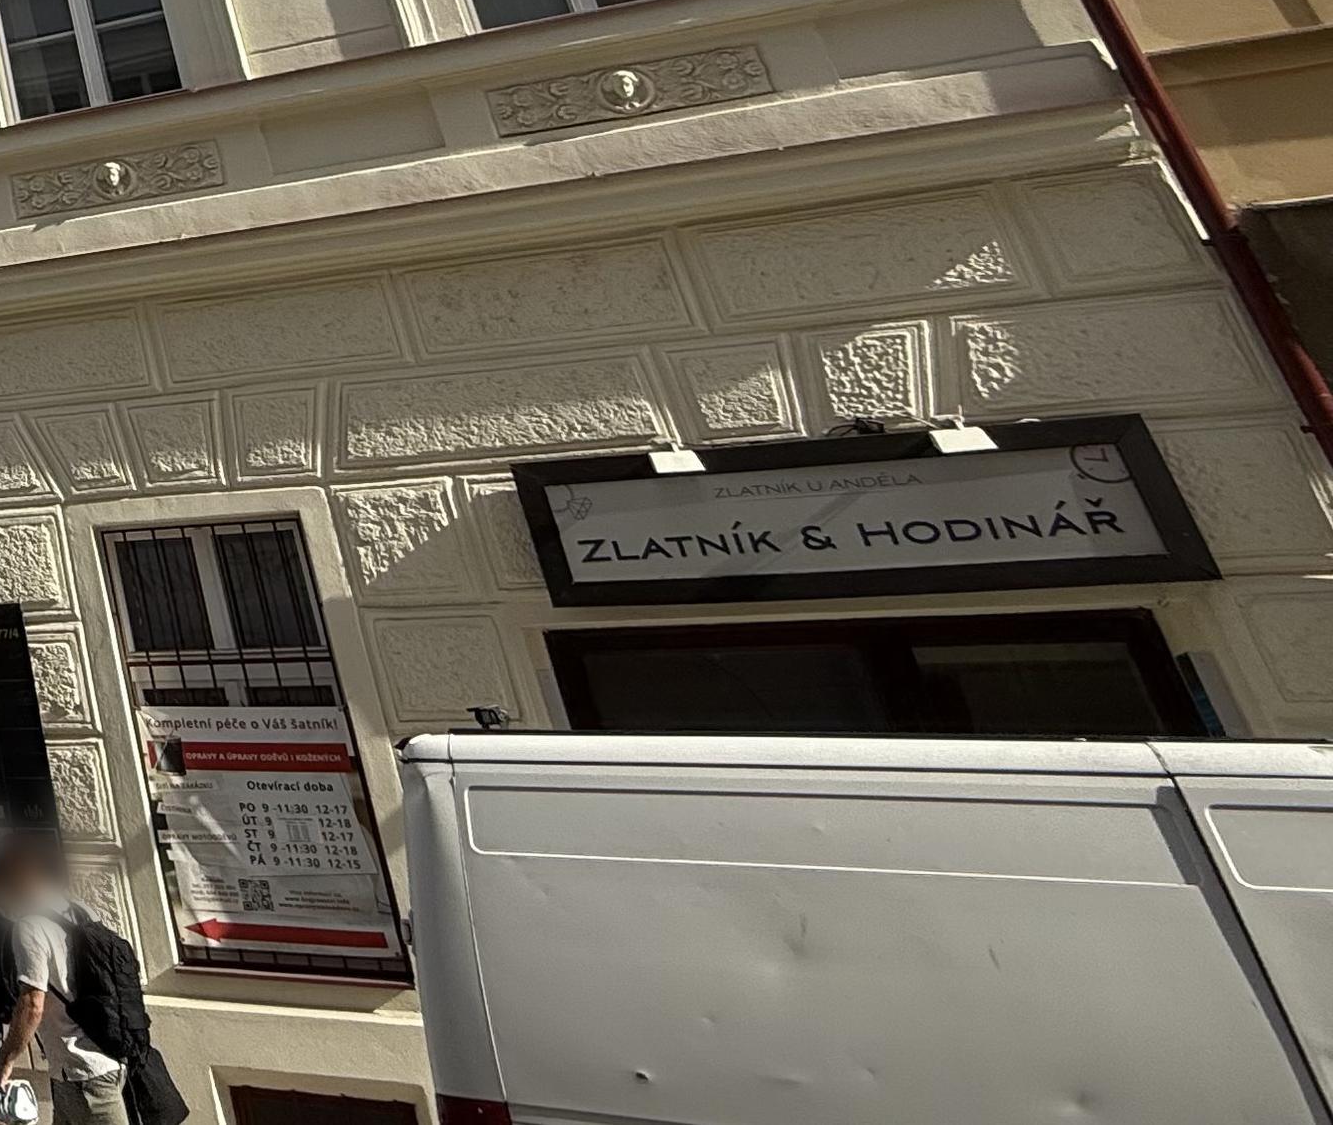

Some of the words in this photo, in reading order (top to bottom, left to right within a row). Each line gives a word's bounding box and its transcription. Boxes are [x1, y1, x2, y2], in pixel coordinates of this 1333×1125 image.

[714, 478, 801, 499] ZLATNÍK
[808, 481, 822, 492] U
[577, 521, 781, 563] ZLATNÍK
[801, 525, 837, 551] &
[856, 497, 1124, 546] HODINÁŘ
[216, 717, 246, 731] péče
[251, 721, 259, 730] o
[262, 717, 287, 730] Váš
[247, 780, 300, 792] Otevírací
[304, 782, 334, 792] doba
[239, 802, 256, 812] PO
[262, 803, 270, 813] 9
[315, 805, 348, 815] 12-17
[242, 814, 258, 826] ÚT
[265, 816, 273, 826] 9
[318, 818, 352, 828] 12-18
[244, 829, 258, 838] ST
[268, 829, 276, 839] 9
[321, 832, 354, 842] 12-17
[247, 840, 262, 851] ČT
[270, 843, 278, 852] 9
[325, 845, 358, 856] 12-18
[250, 854, 267, 866] PÁ
[273, 856, 281, 866] 9
[328, 859, 361, 870] 12-15
